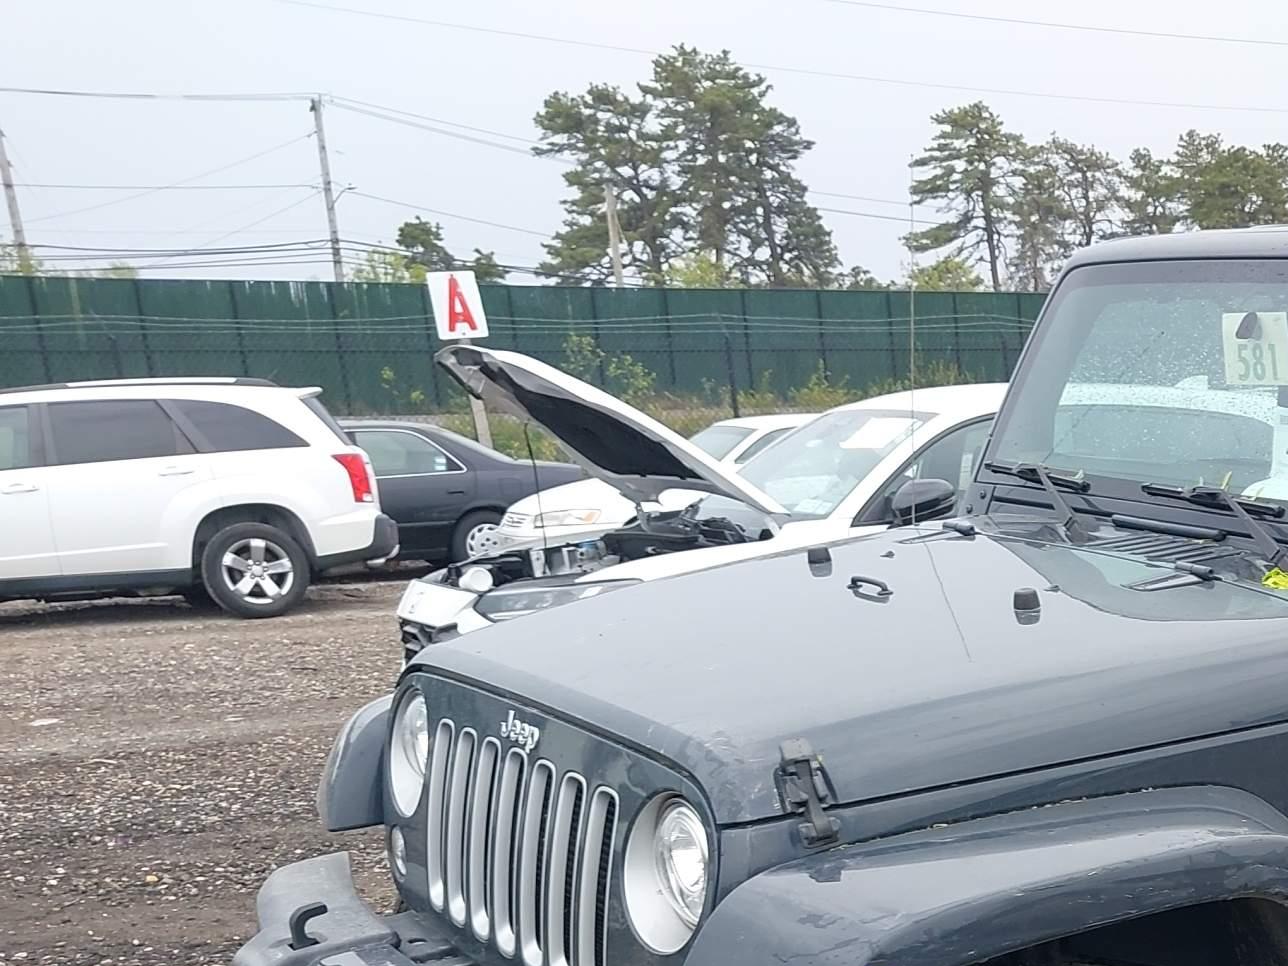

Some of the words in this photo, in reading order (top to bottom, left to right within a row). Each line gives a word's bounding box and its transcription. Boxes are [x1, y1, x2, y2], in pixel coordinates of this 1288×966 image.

[448, 277, 478, 333] A
[1236, 343, 1280, 382] 581
[500, 709, 540, 754] Jeep
